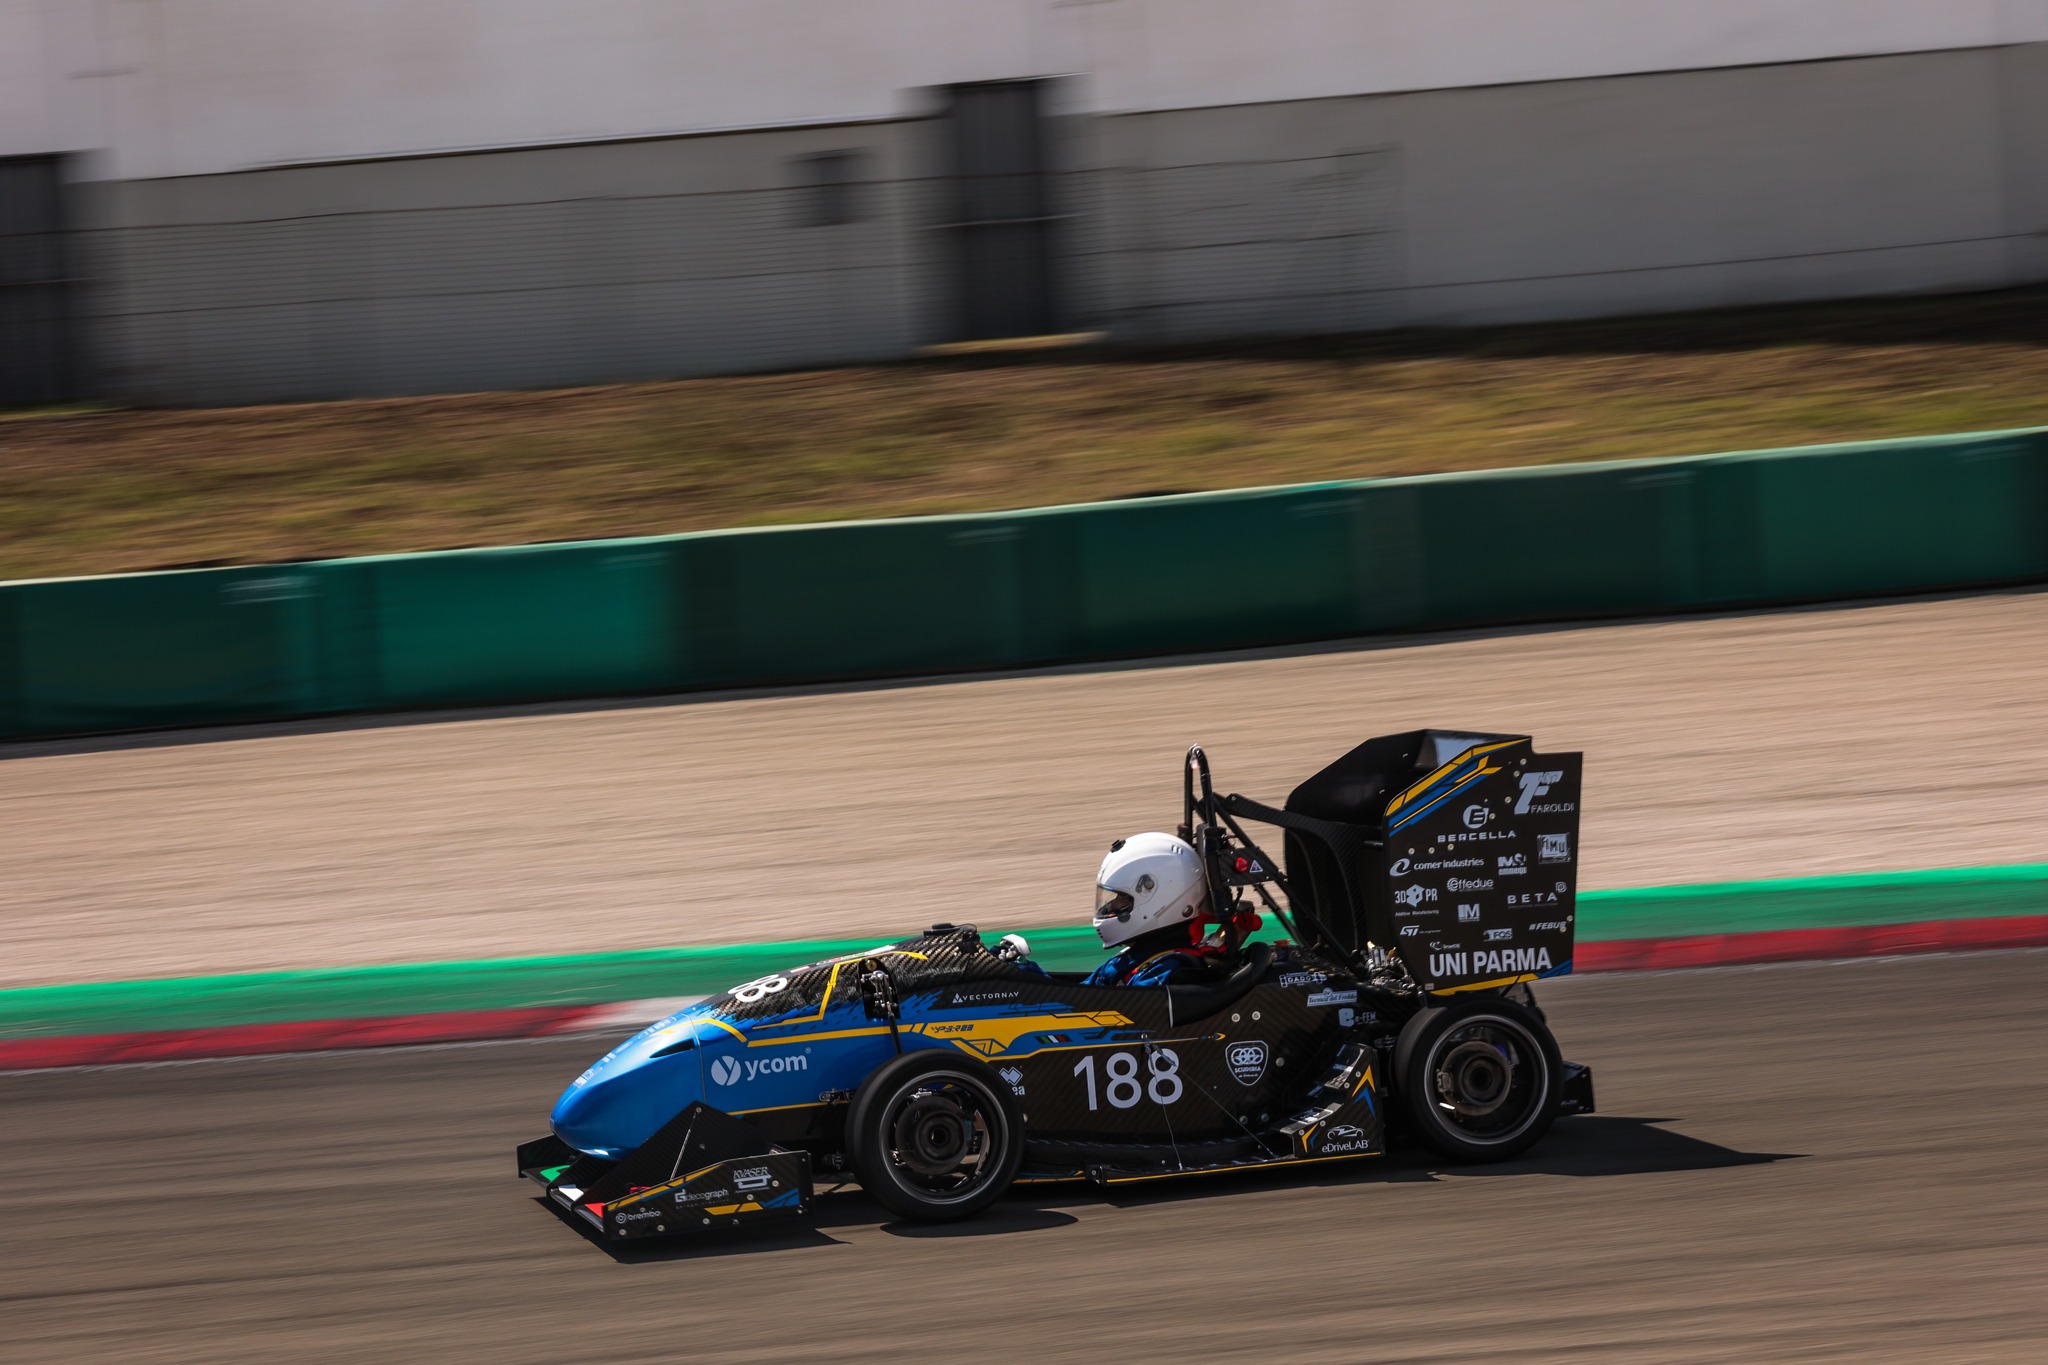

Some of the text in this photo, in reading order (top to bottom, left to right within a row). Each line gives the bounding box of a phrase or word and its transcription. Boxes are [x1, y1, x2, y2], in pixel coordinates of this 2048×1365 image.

[1530, 803, 1575, 814] FAROLDI
[1437, 830, 1517, 843] BERCELLA
[1413, 857, 1484, 870] comer industries
[1447, 877, 1494, 891] effedue
[1425, 888, 1438, 901] PR
[1507, 892, 1558, 904] BETA
[1429, 947, 1552, 977] UNI PARMA
[962, 992, 1019, 1001] VECTORNAV
[744, 1055, 808, 1081] ycom
[1073, 1048, 1183, 1111] 188
[1322, 1140, 1369, 1153] eDriveLAB
[733, 1166, 769, 1179] KVASER
[686, 1188, 729, 1201] decograph
[627, 1209, 661, 1221] brembo
